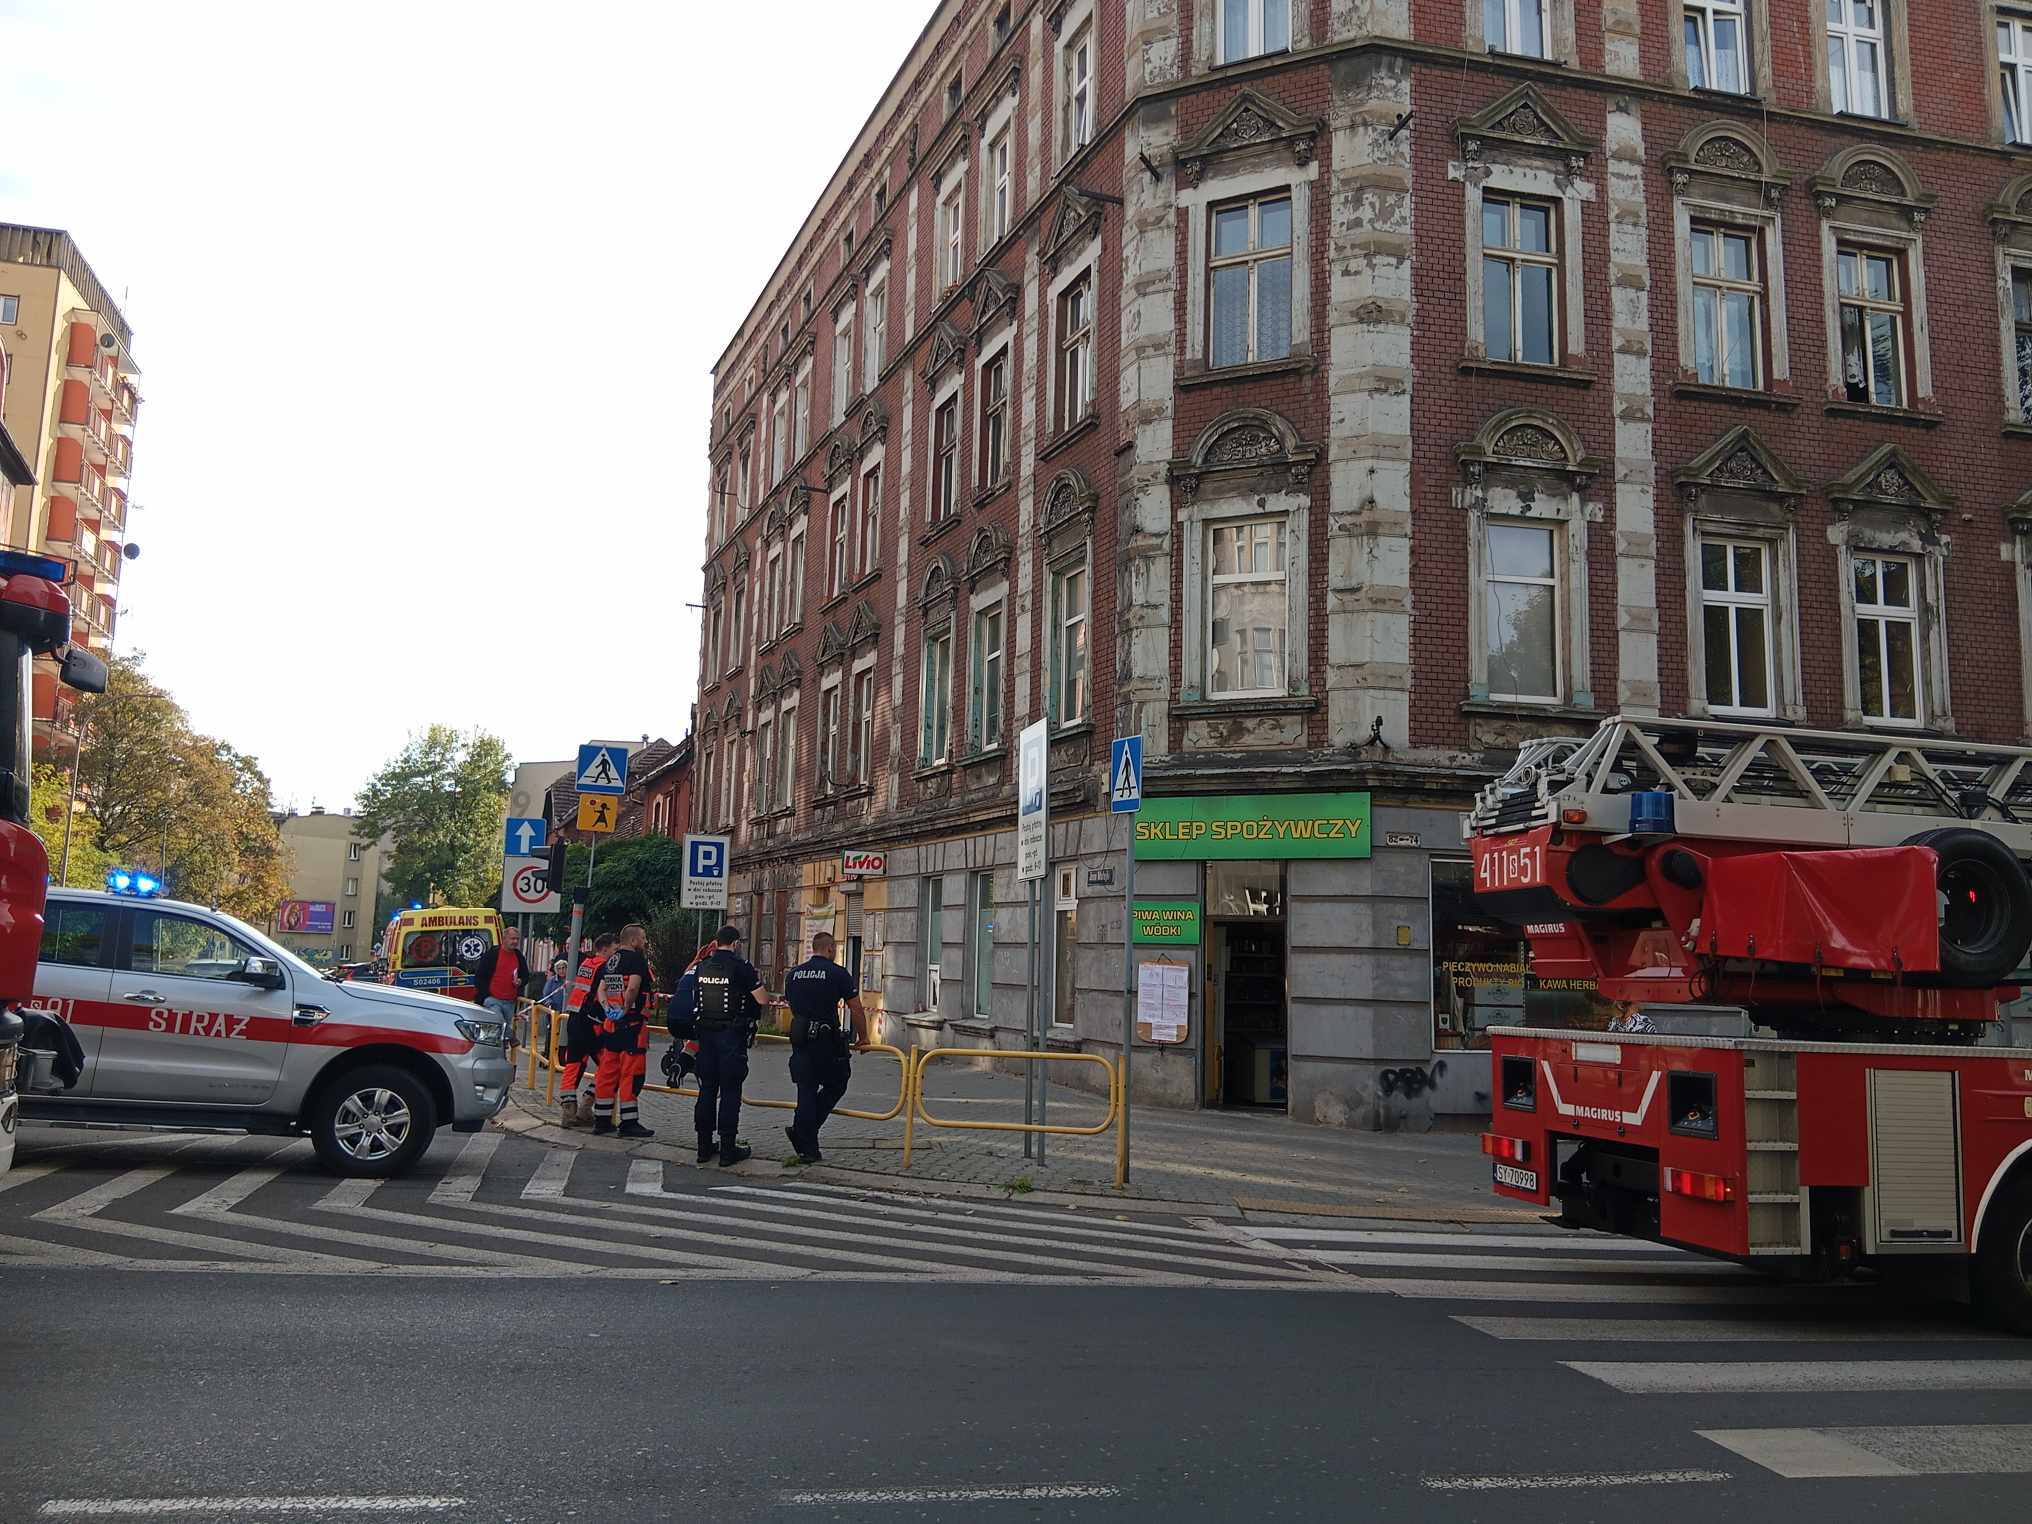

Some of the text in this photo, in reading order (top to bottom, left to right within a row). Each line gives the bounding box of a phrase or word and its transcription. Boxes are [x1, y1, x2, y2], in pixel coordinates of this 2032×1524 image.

[1135, 815, 1362, 840] SKLEP SPOŻYWCZY
[520, 877, 545, 893] 30
[421, 915, 479, 927] AMBULANS
[1162, 910, 1194, 920] WINA
[1143, 923, 1182, 936] WÓDKI
[1527, 923, 1565, 935] MAGIRUS
[698, 977, 729, 985] POLICJA
[793, 970, 825, 980] POLICJA
[1540, 978, 1567, 991] KAWA
[1575, 1105, 1622, 1123] MAGIRUS
